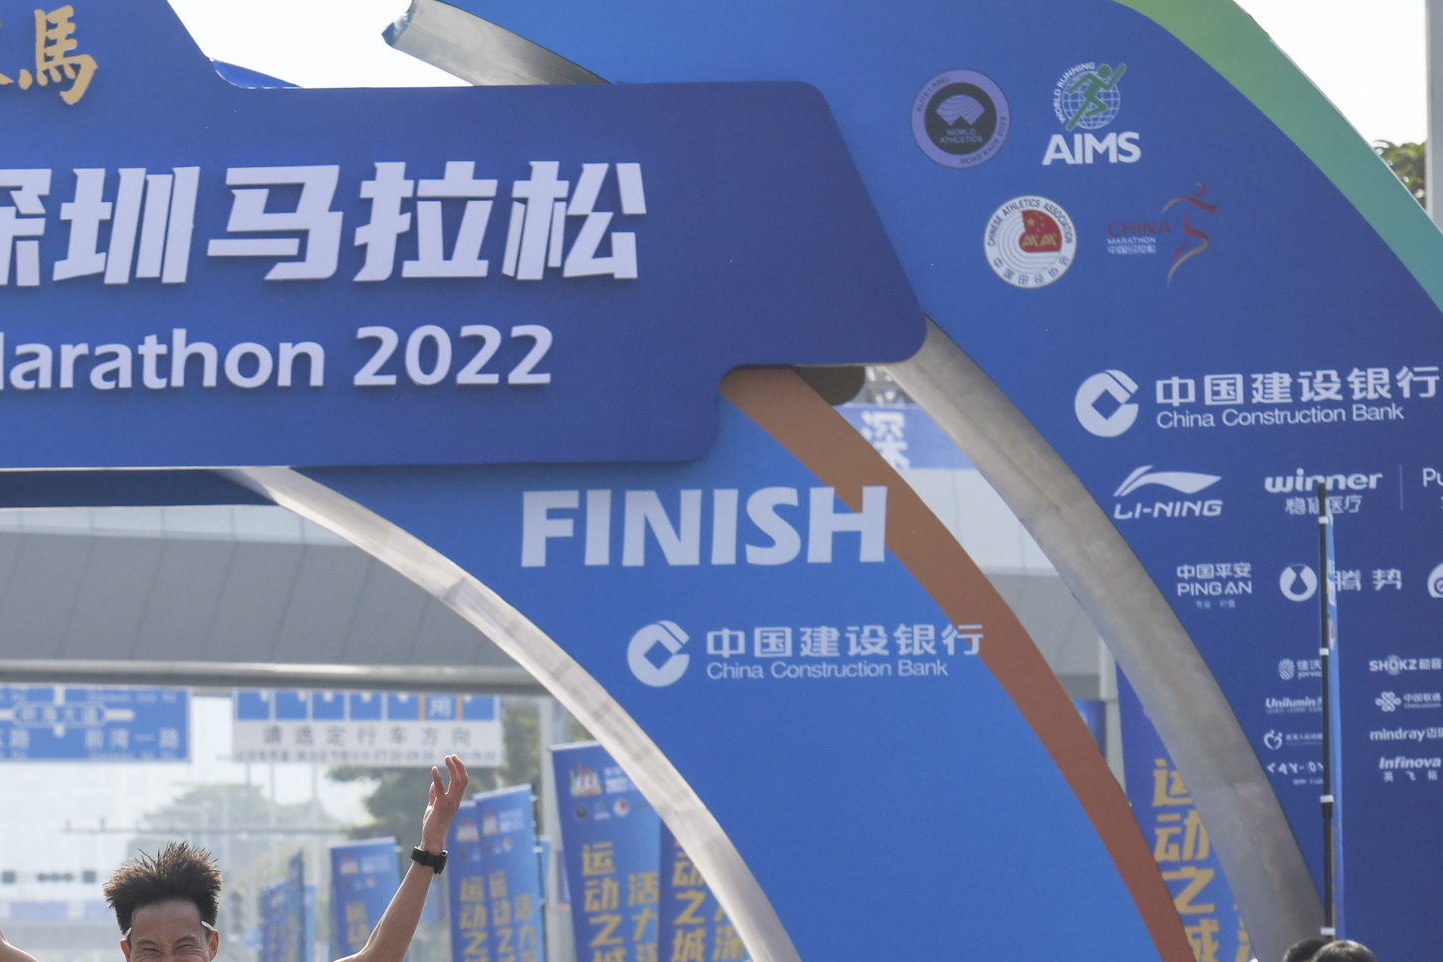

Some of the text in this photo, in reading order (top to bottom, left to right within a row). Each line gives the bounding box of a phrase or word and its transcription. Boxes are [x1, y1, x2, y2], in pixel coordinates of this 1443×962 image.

[1056, 62, 1096, 88] RUNNING
[1042, 131, 1141, 166] AIMS
[1107, 236, 1156, 245] MARATHON
[1108, 220, 1171, 237] CHINA
[354, 324, 553, 387] 2022
[1156, 366, 1441, 407] 中国建设银行
[1157, 402, 1405, 429] China Construction Bank
[1264, 467, 1384, 493] winner
[1114, 500, 1223, 520] LI-NING
[521, 486, 888, 567] FINISH
[1176, 561, 1252, 580] 中国平安
[706, 624, 984, 659] 中国建设银行
[706, 658, 949, 680] China Construction Bank
[1369, 659, 1418, 671] SHOKZ
[1370, 728, 1426, 742] mindray
[1379, 756, 1442, 769] Infinova
